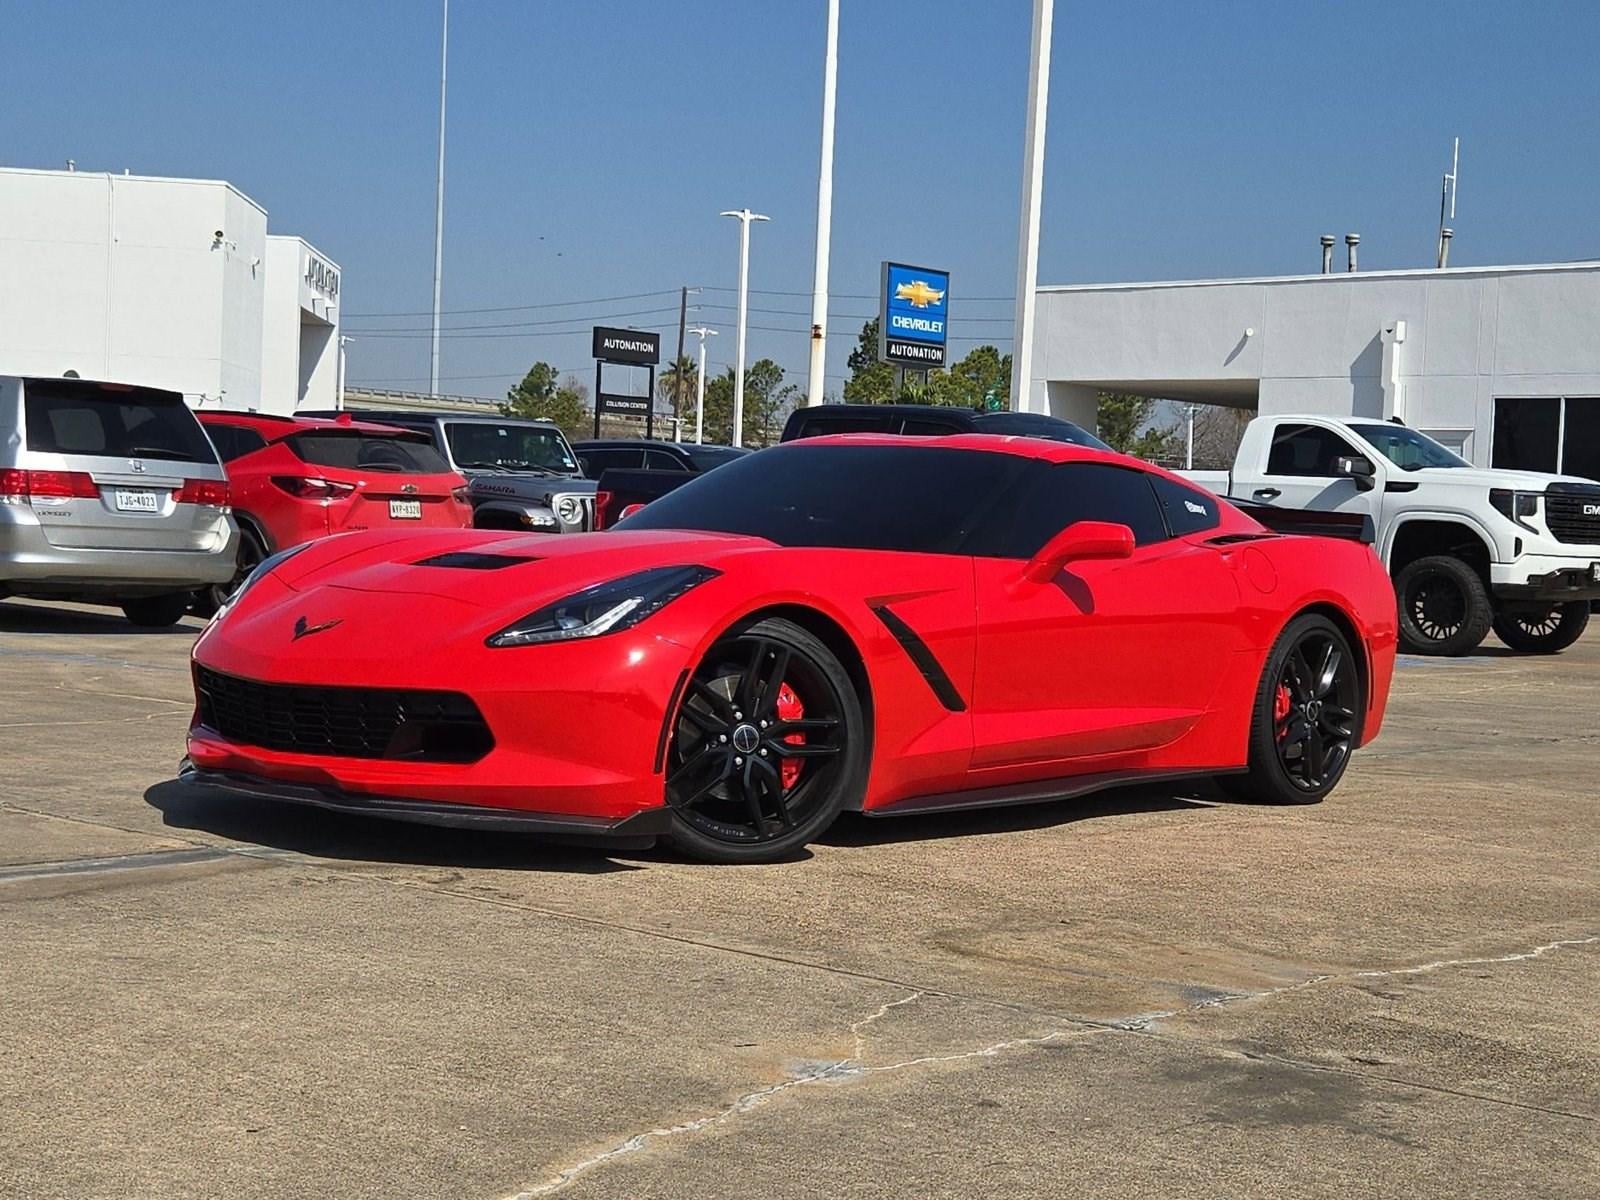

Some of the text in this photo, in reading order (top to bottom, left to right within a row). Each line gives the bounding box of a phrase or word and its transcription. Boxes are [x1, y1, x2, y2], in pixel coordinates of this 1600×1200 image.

[892, 315, 944, 333] CHEVROLET
[603, 338, 654, 353] AUTONATION
[890, 343, 943, 361] AUTONATION
[606, 400, 648, 410] COLLISION CENTER
